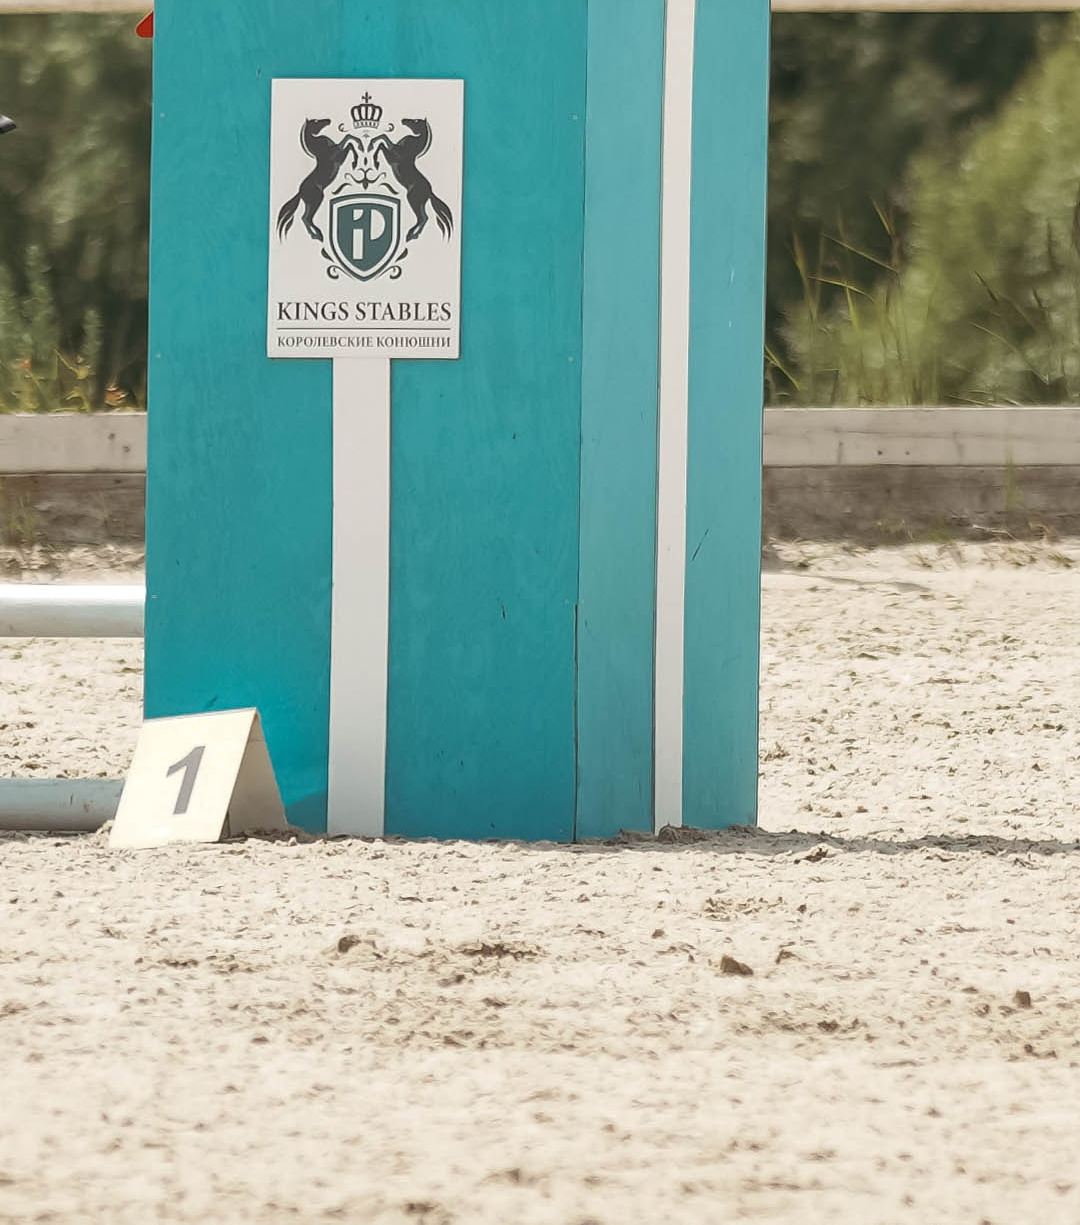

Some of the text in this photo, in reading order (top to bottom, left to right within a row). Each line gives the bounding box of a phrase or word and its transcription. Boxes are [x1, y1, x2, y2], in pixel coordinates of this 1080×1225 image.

[277, 301, 452, 321] KINGS STABLES
[277, 336, 451, 348] КОРОЛЕВСКИЕ КОНЮШНИ
[166, 745, 206, 815] 1
